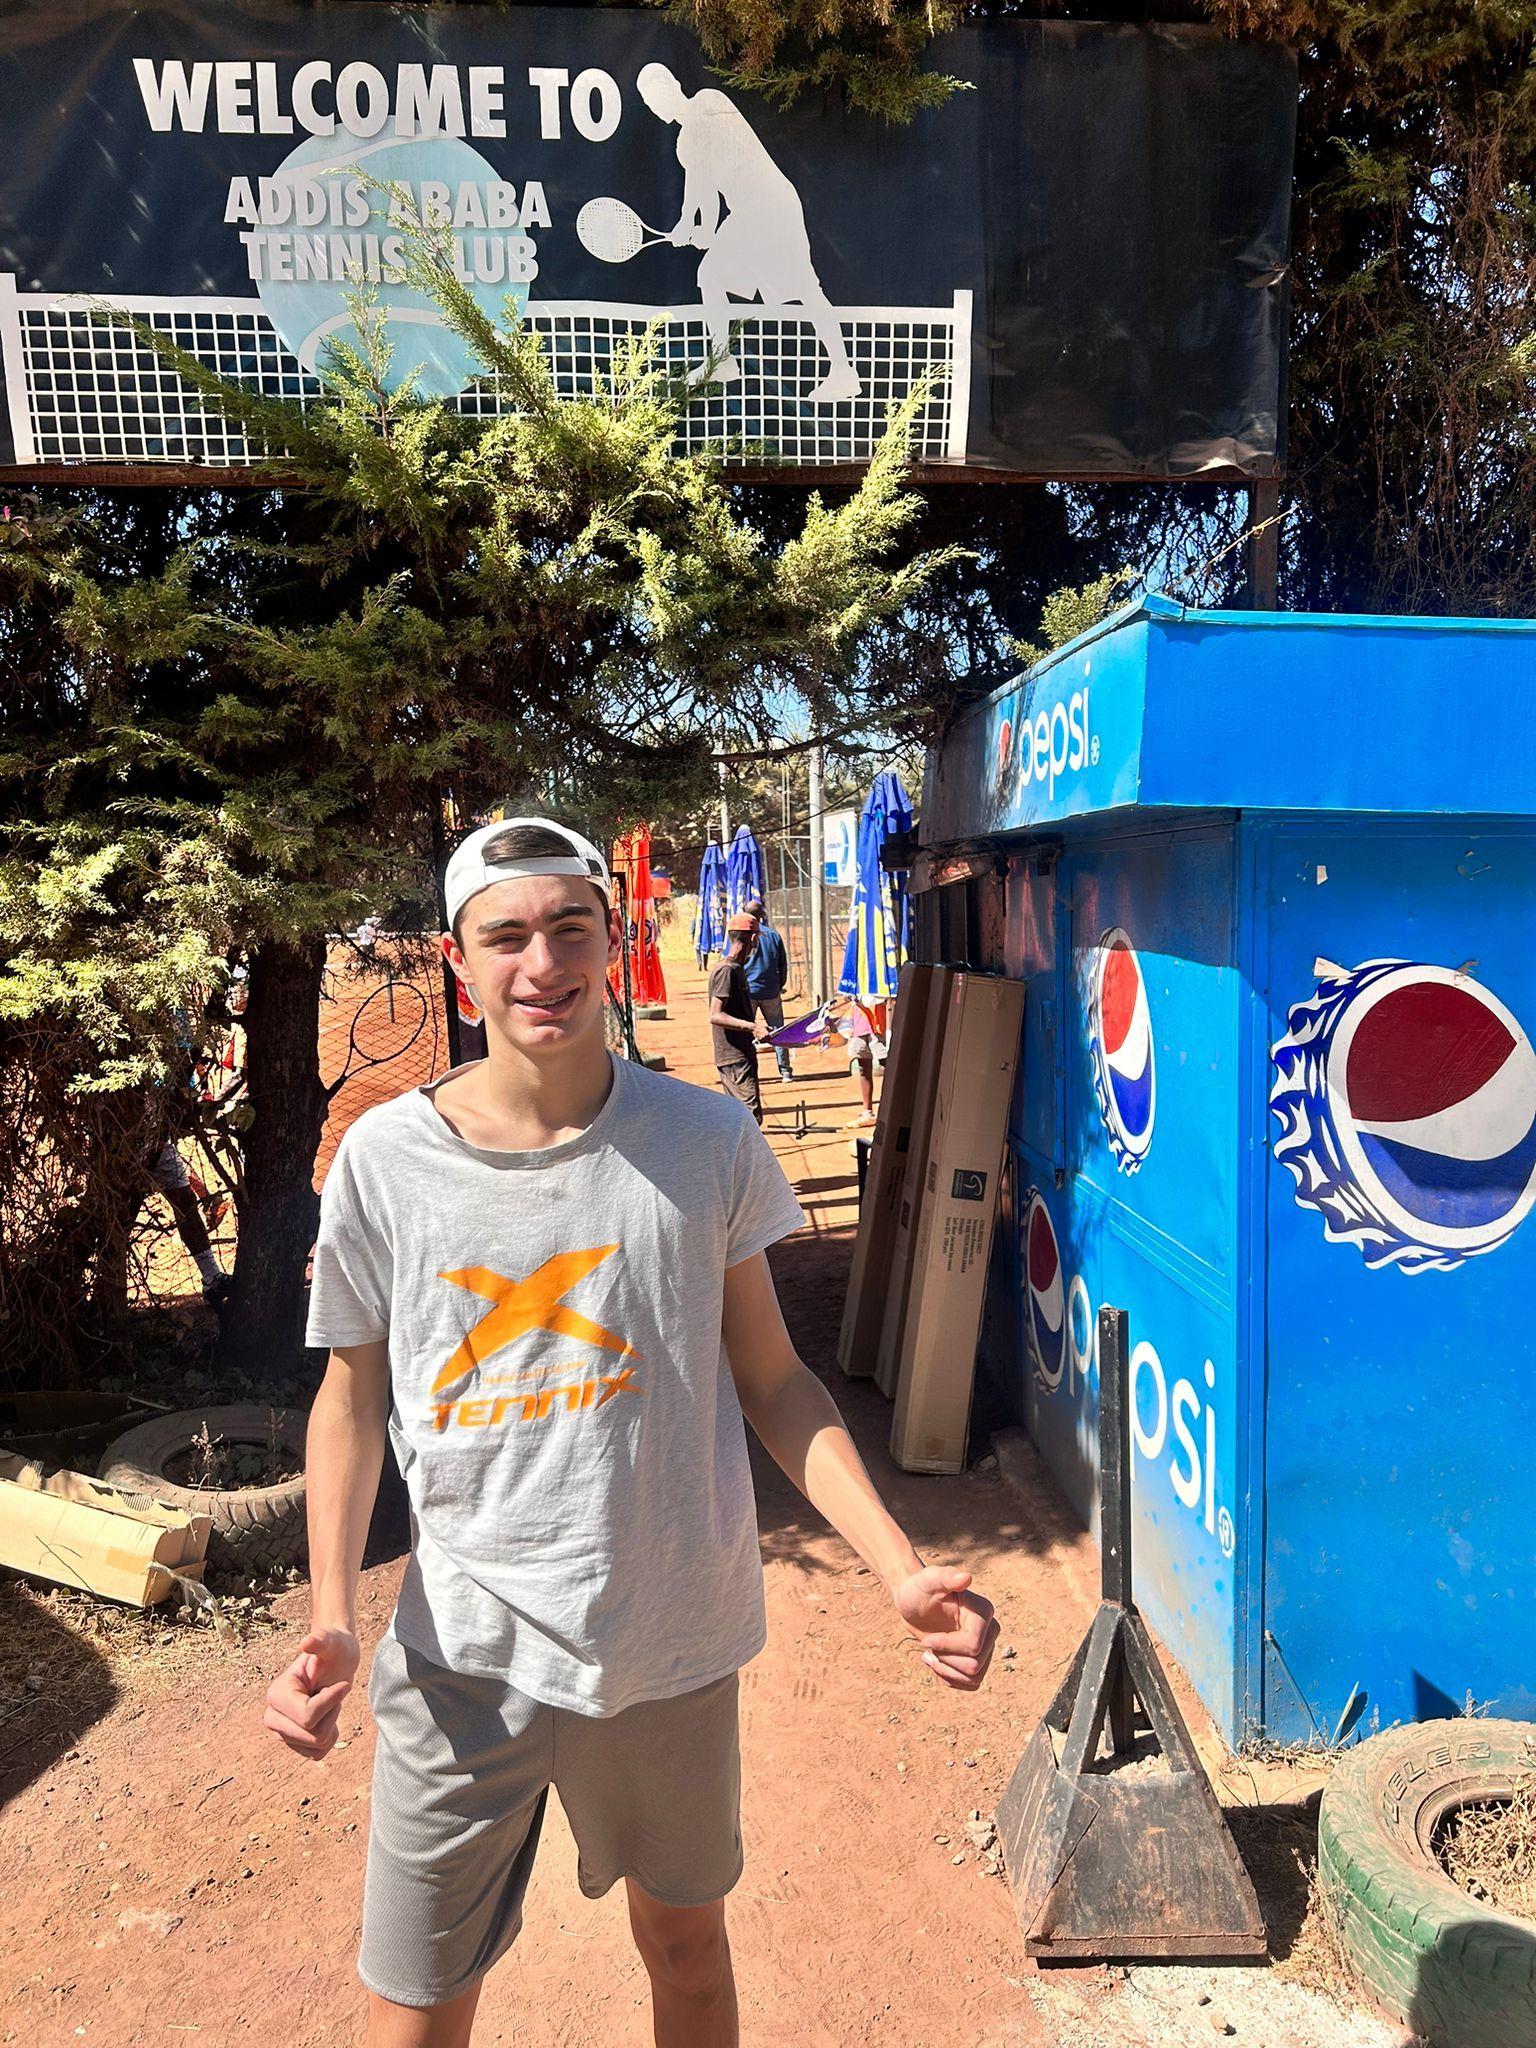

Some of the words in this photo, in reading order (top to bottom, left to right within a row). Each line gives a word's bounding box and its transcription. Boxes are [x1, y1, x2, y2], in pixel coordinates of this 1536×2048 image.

[132, 58, 507, 139] WELCOME
[528, 66, 622, 142] TO
[223, 176, 370, 227] ADDIS
[387, 180, 552, 229] ABABA
[239, 231, 408, 285] TENNIS
[424, 234, 540, 284] LUB
[1068, 1274, 1215, 1536] ppsi
